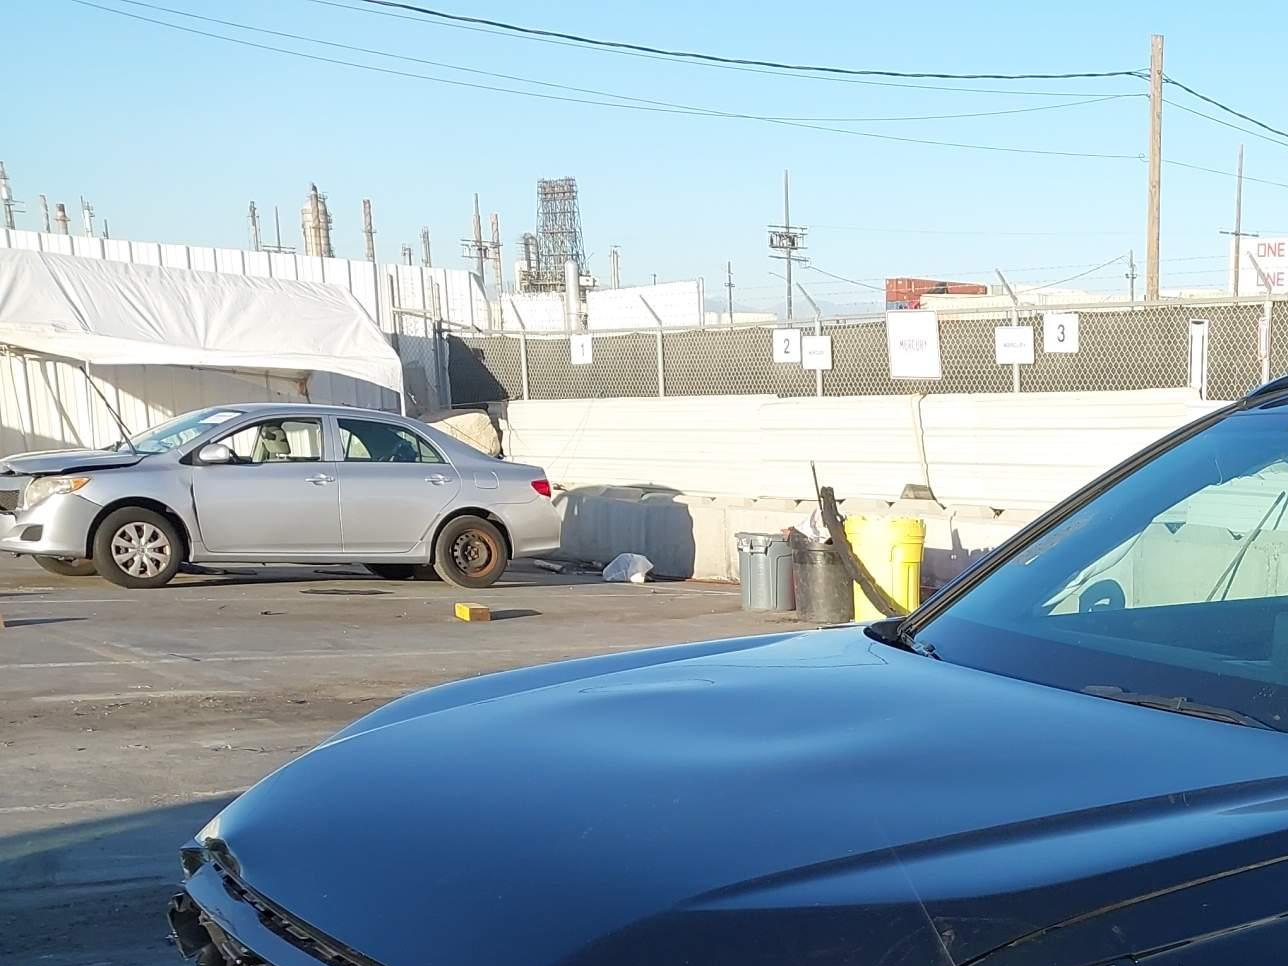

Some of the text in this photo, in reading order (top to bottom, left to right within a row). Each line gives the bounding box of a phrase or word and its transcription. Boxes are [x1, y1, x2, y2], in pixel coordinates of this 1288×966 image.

[1257, 242, 1285, 258] ONE
[1057, 323, 1065, 342] 3
[783, 337, 790, 354] 2
